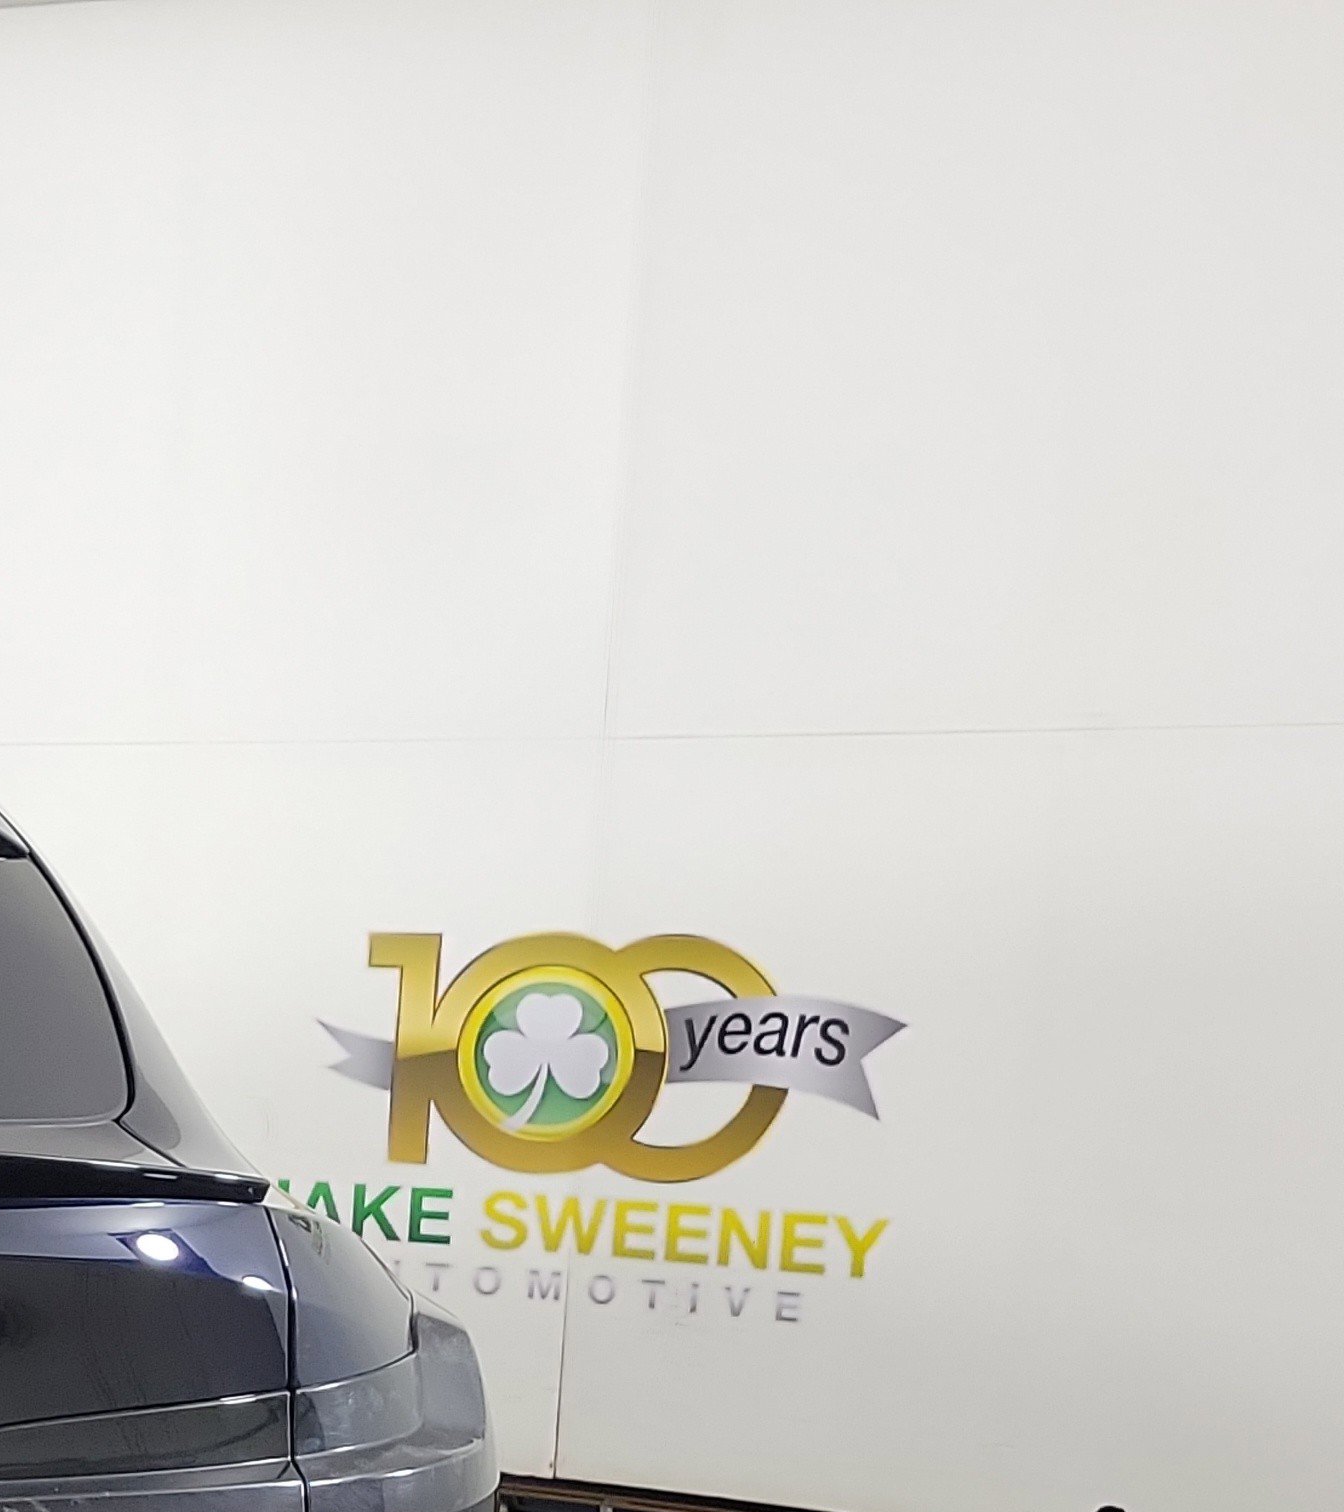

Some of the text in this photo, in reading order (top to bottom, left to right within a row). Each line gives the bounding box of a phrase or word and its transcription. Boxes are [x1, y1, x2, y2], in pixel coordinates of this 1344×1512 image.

[368, 931, 850, 1183] 100 years
[276, 1178, 891, 1280] AKE SWEENEY
[393, 1258, 802, 1323] TOMOTIVE
